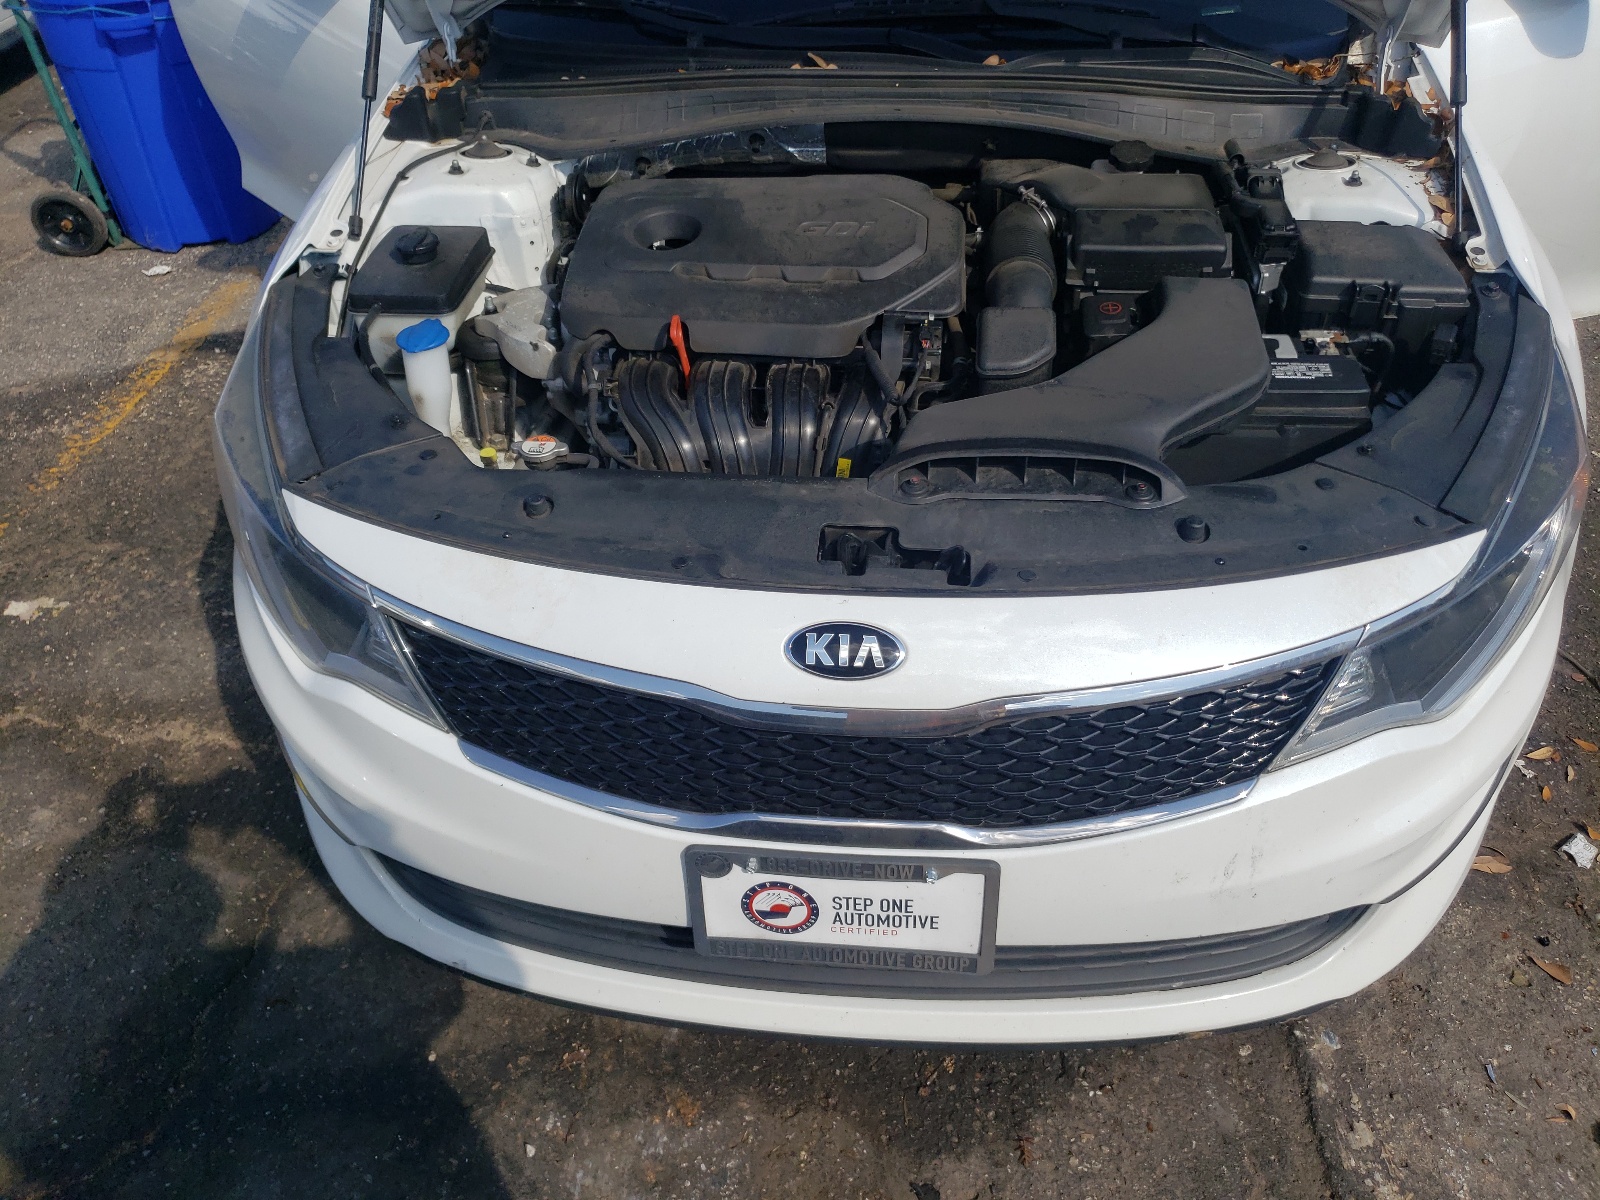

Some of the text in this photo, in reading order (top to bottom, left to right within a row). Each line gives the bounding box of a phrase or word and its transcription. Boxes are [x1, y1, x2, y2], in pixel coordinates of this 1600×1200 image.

[805, 632, 885, 668] KIA
[831, 896, 914, 914] STEP ONE
[832, 911, 940, 930] AUTOMOTIVE
[830, 926, 899, 936] CERTIFIED
[715, 940, 756, 957] STEP
[801, 946, 907, 968] AUTOMOTIVE
[912, 954, 970, 972] GROUP
